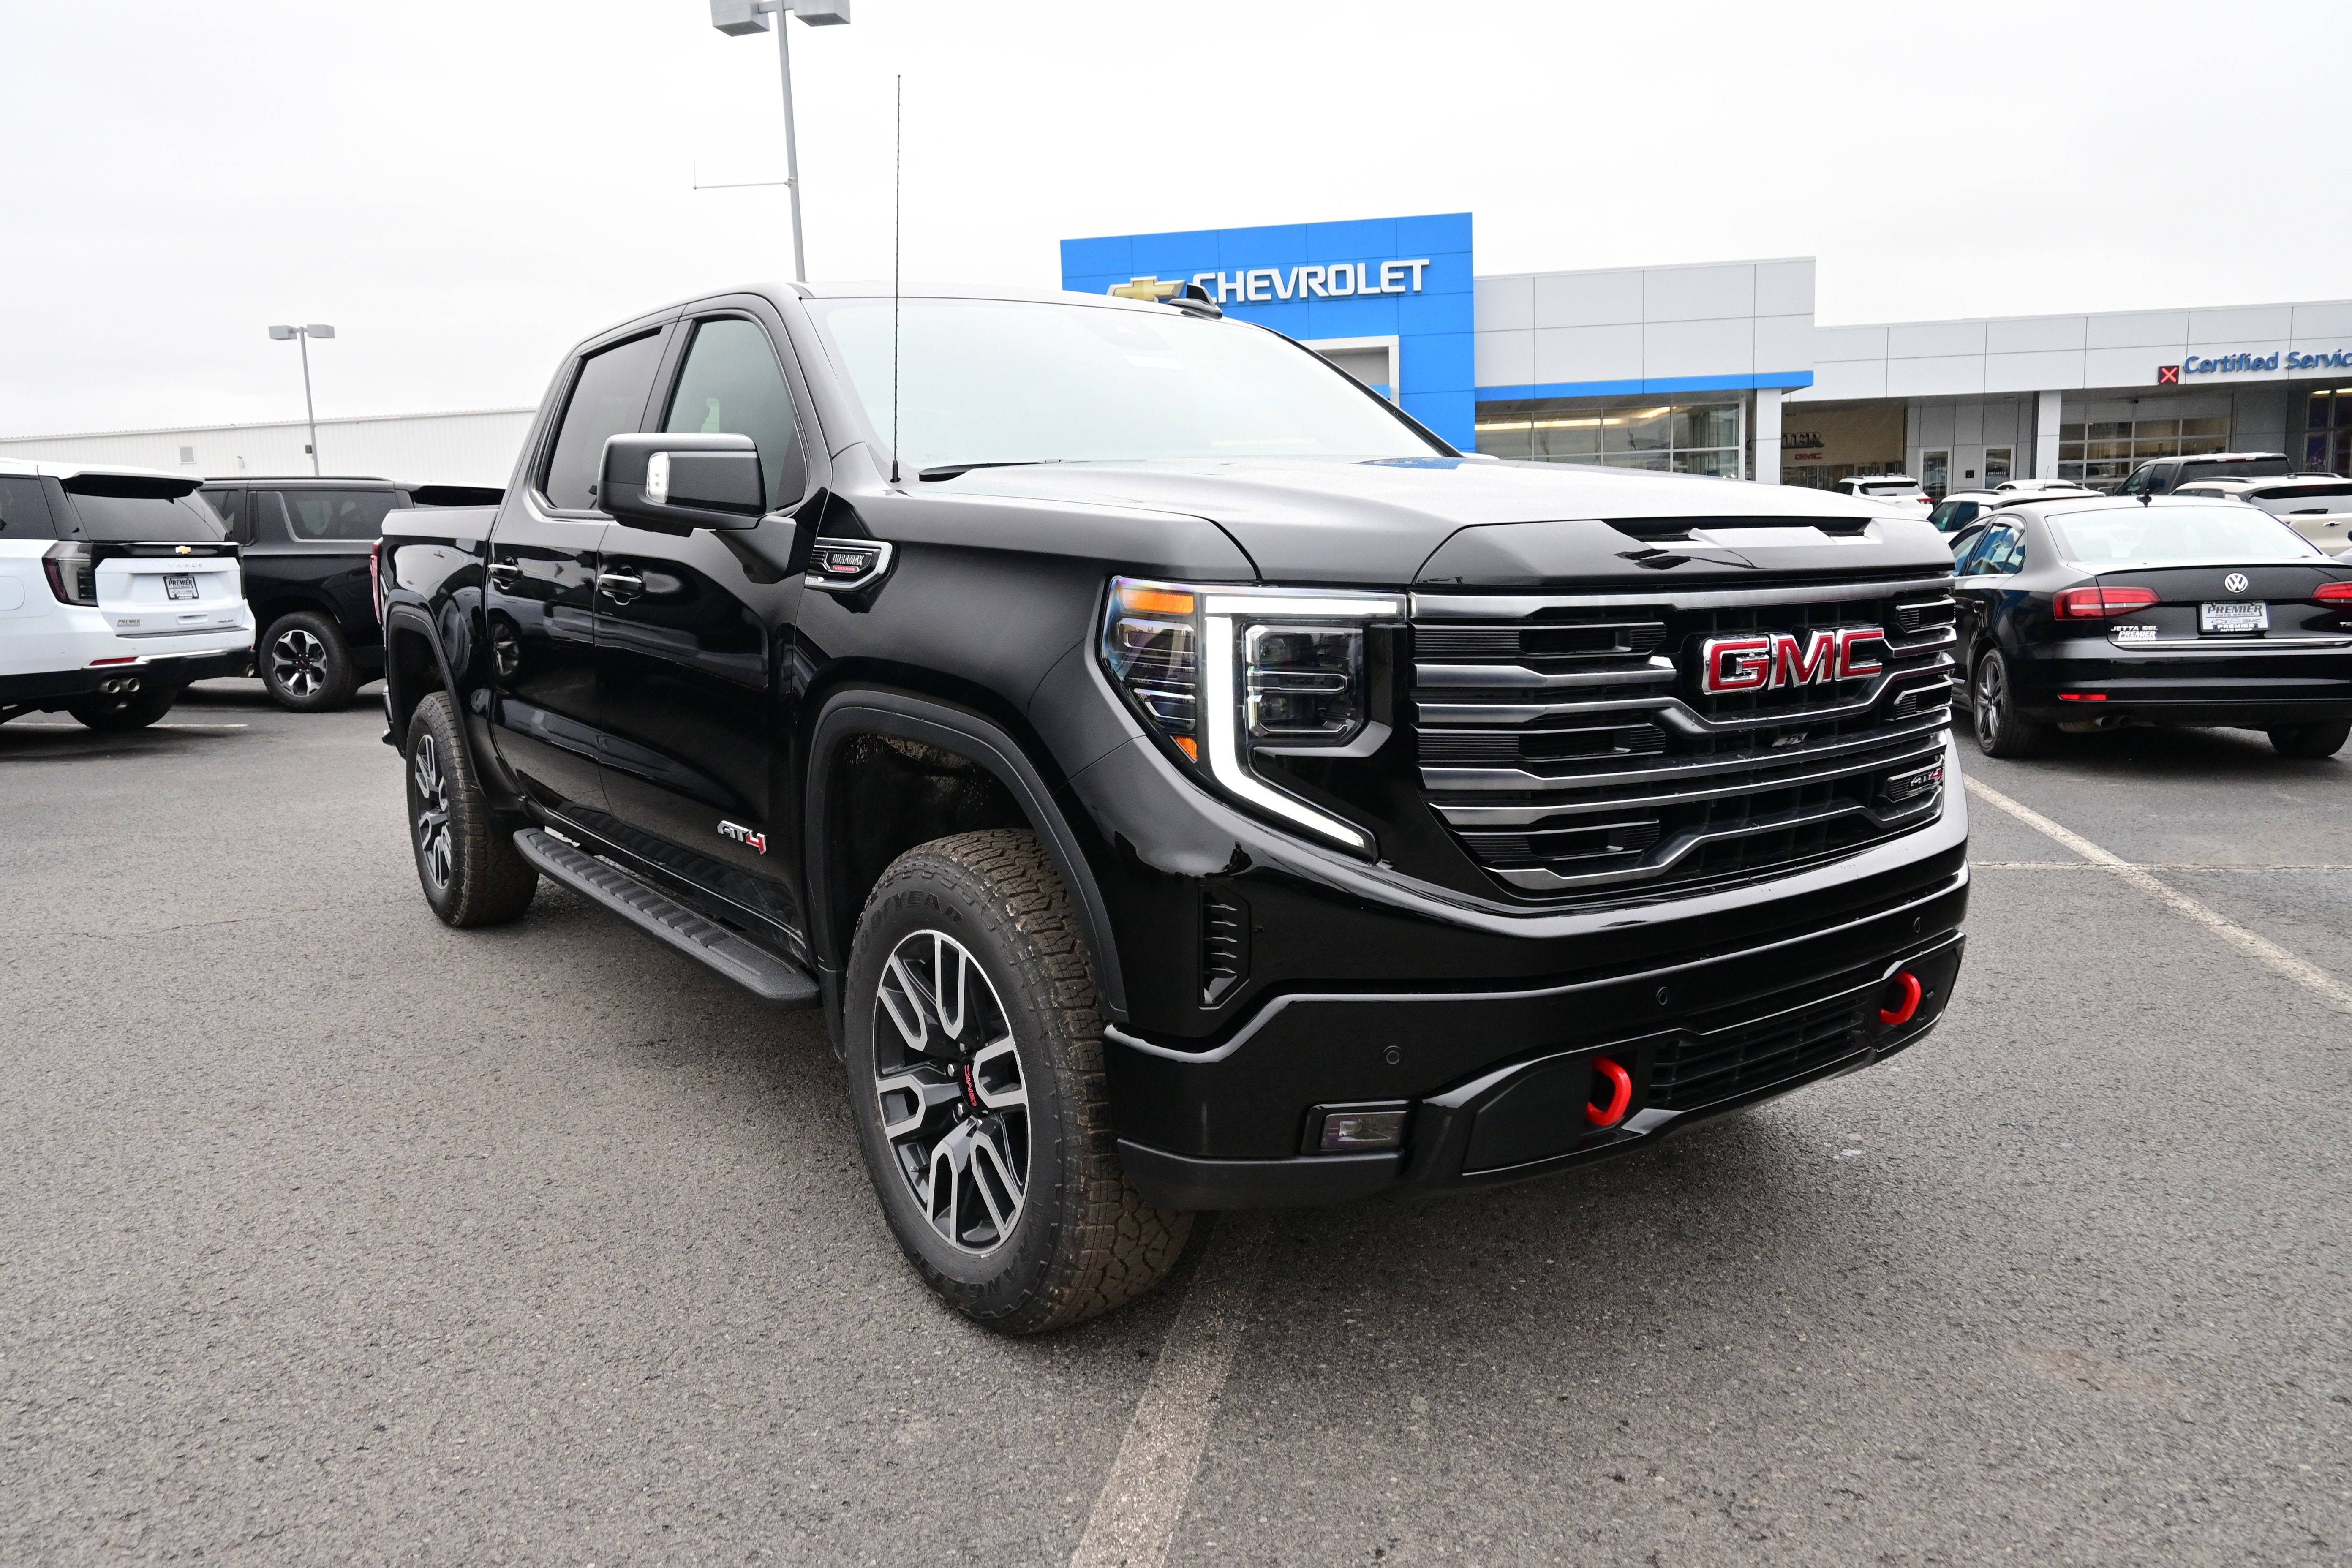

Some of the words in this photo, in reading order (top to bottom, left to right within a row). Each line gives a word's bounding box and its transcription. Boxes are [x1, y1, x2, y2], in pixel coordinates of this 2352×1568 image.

[1192, 259, 1430, 303] CHEVROLET
[2184, 351, 2279, 373] Certified
[831, 554, 864, 566] DURAMAX
[169, 579, 193, 588] PREMIER
[2207, 605, 2262, 616] PREMIER
[1701, 628, 1884, 695] GMC
[1911, 767, 1943, 787] AT4
[717, 820, 767, 855] AT4
[964, 1064, 977, 1106] GMC
